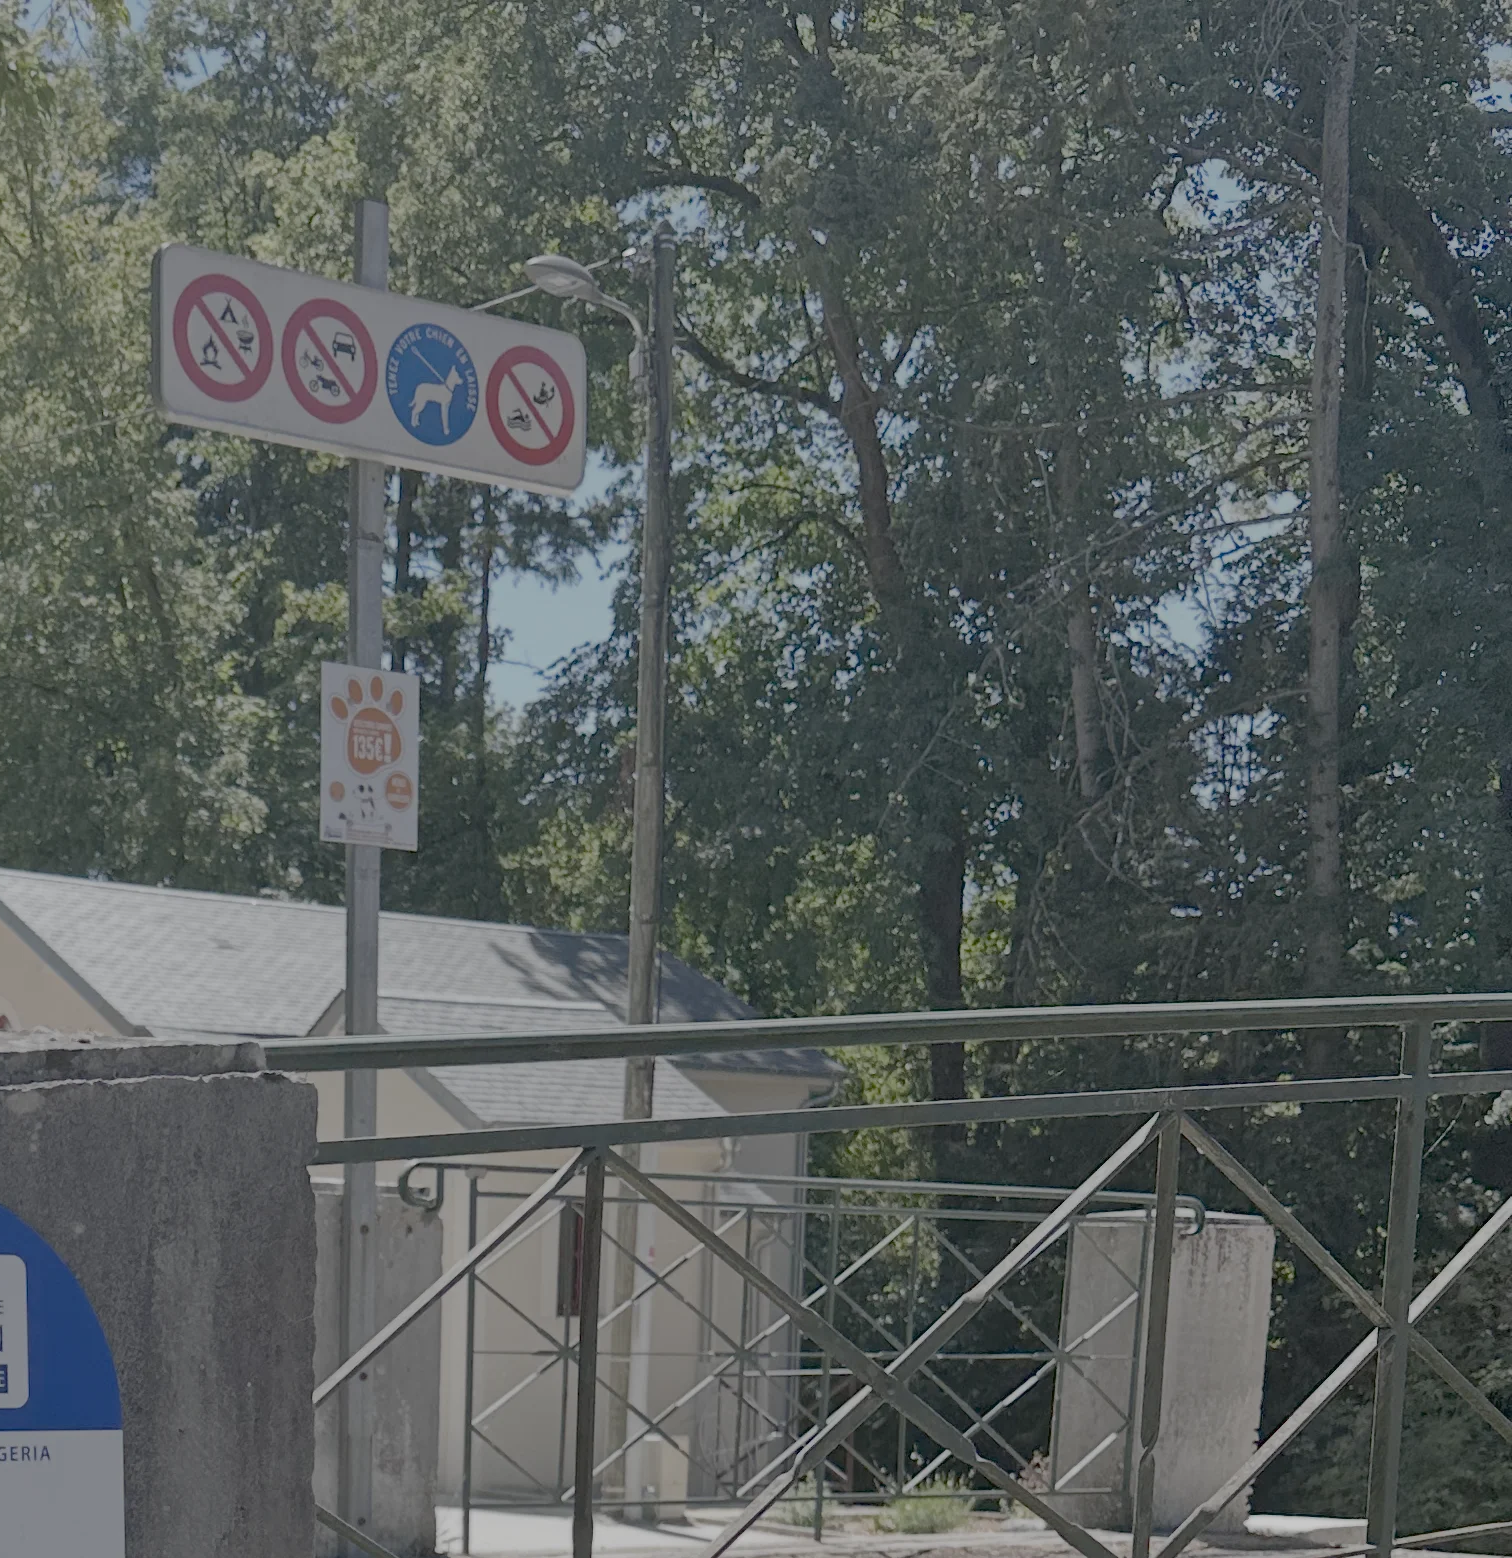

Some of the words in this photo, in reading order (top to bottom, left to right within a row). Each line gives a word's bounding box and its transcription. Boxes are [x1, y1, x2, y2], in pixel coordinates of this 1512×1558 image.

[388, 357, 399, 396] TENEZ
[394, 328, 422, 355] VOTRE
[425, 327, 455, 349] CHIEN
[456, 347, 468, 364] EN
[464, 368, 478, 412] LAISSE
